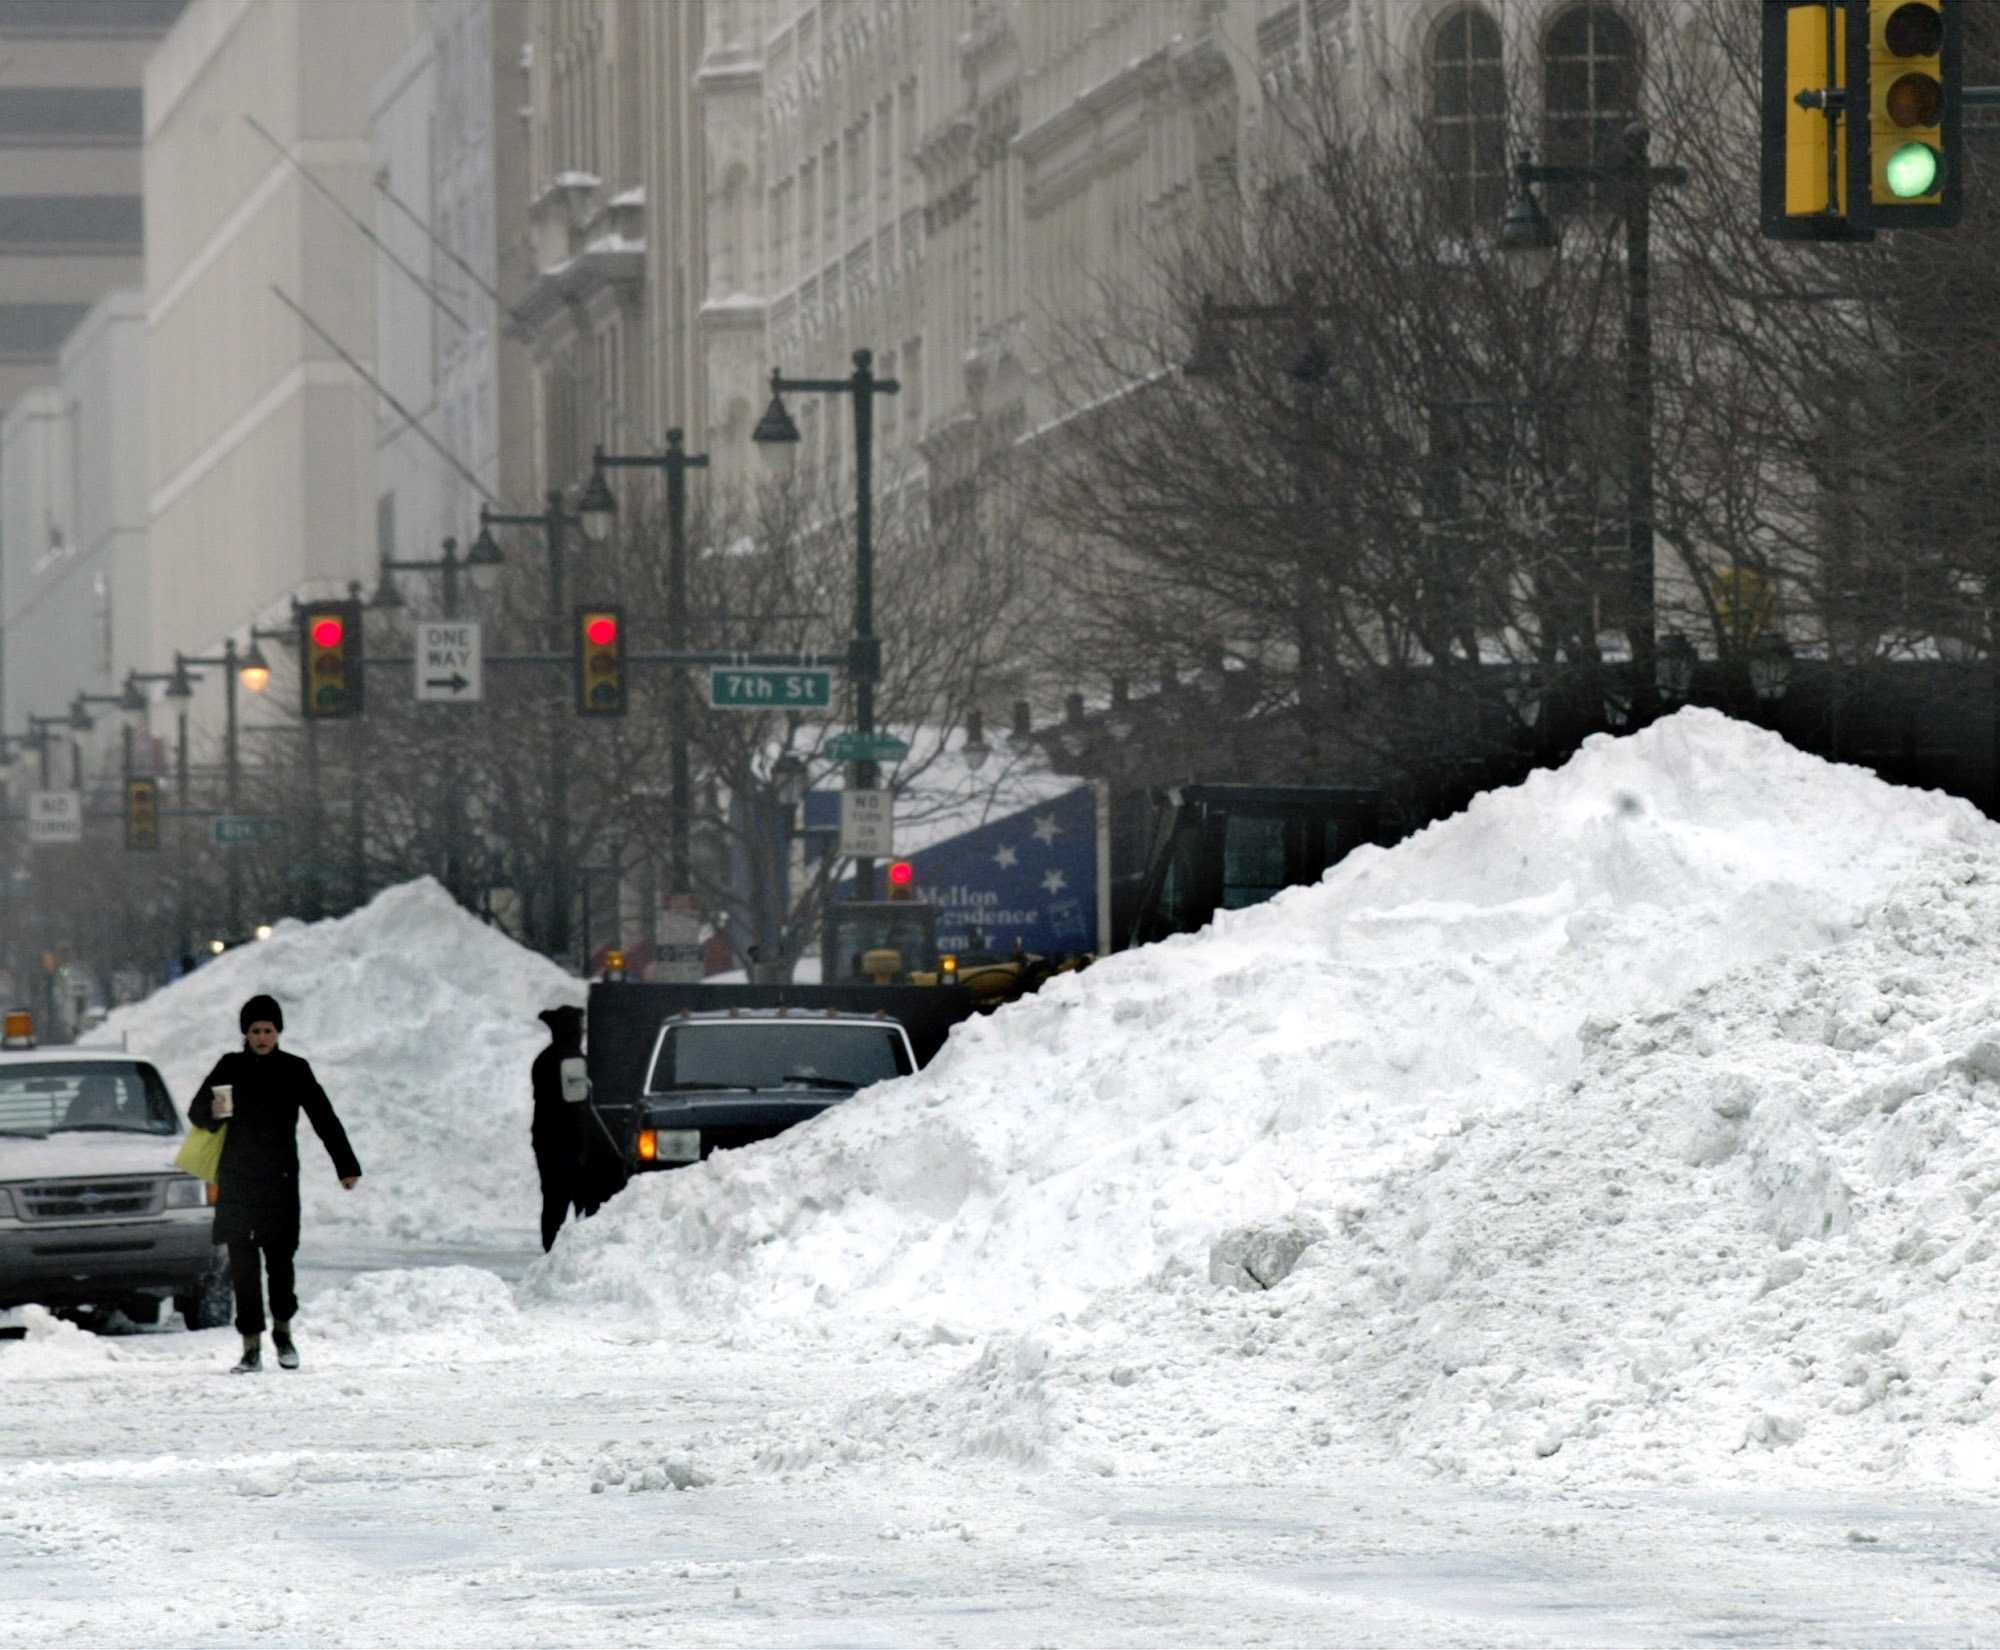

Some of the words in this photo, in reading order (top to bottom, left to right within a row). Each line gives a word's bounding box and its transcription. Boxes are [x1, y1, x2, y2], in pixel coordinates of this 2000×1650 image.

[428, 628, 468, 646] ONE
[428, 650, 472, 667] WAY
[728, 676, 773, 698] 7th
[786, 676, 816, 698] St
[916, 884, 999, 906] Mellon
